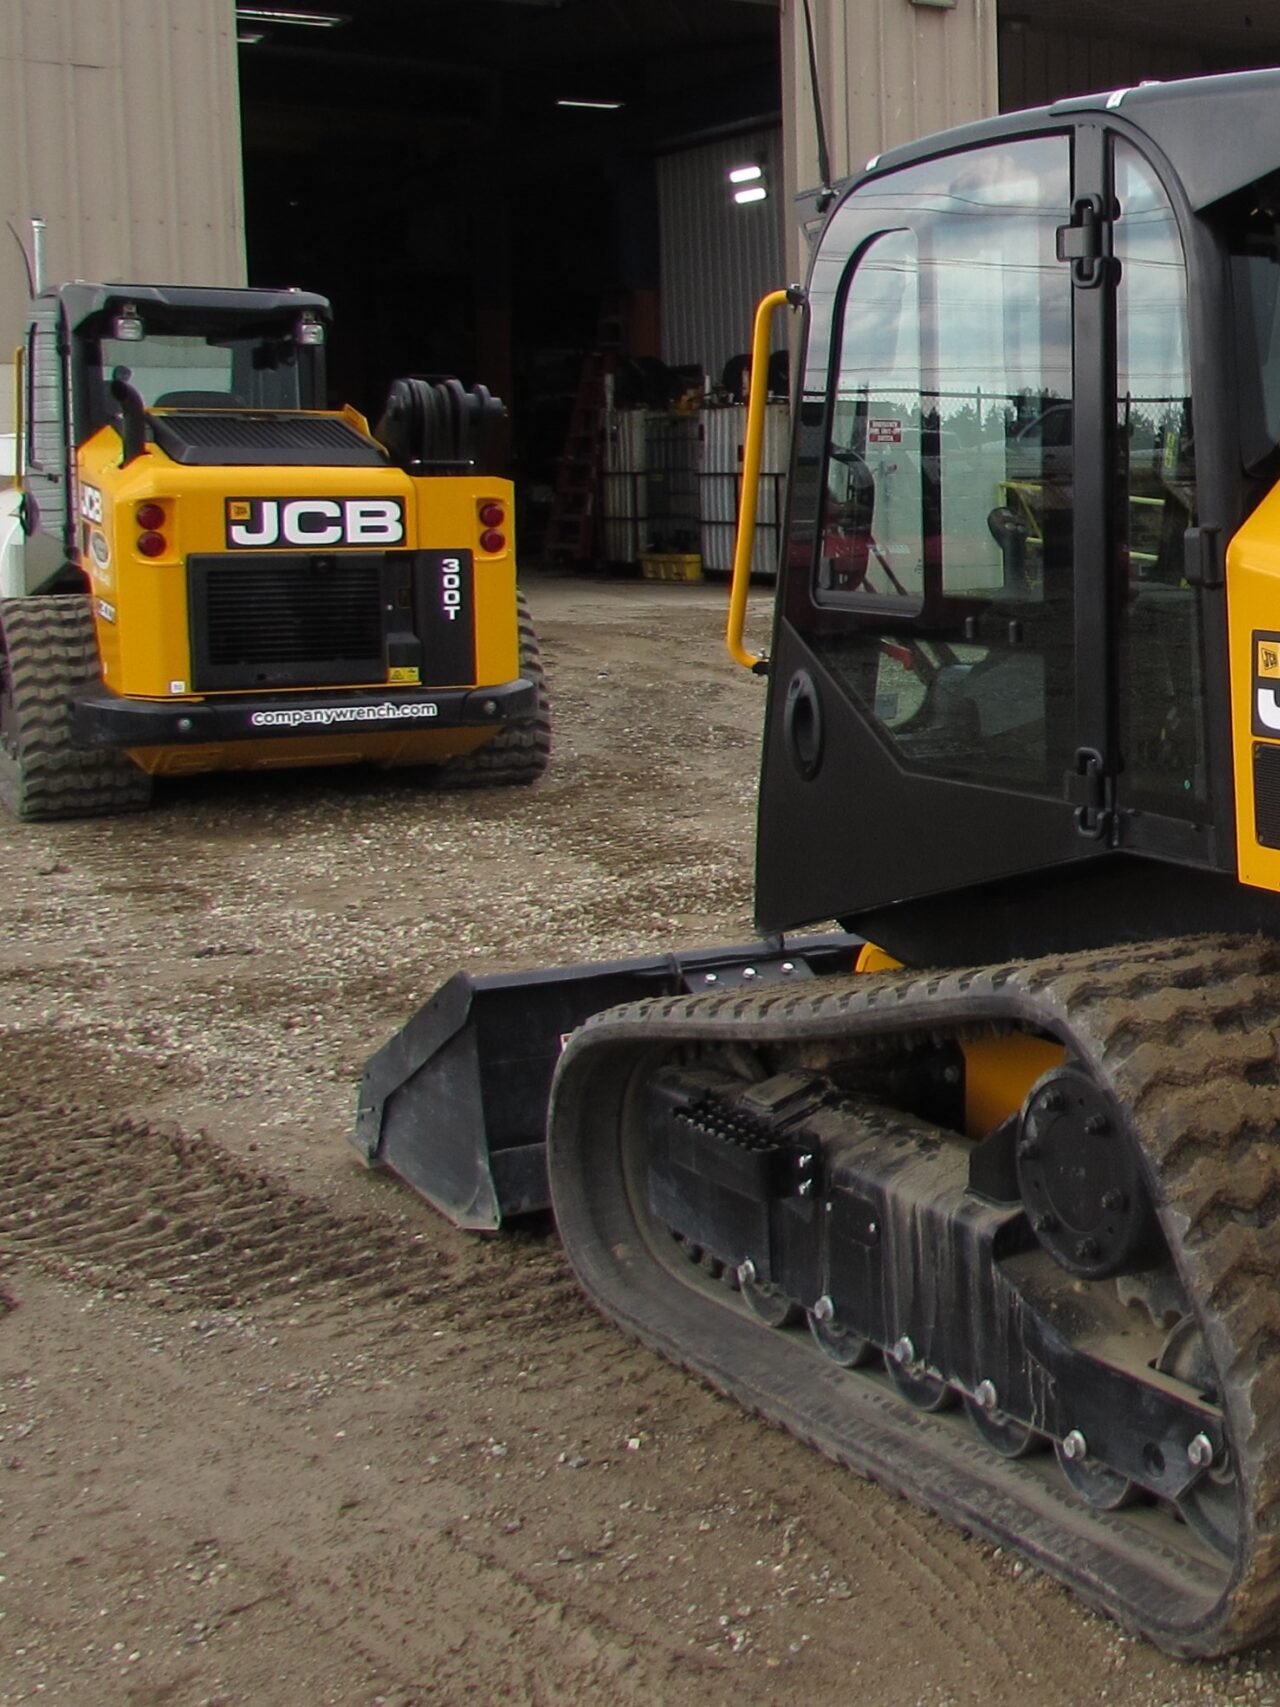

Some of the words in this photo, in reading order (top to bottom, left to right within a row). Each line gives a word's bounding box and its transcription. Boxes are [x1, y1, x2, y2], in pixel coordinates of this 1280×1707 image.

[231, 500, 404, 545] JCB
[442, 558, 461, 620] 300T
[252, 703, 437, 726] companywrench.com
